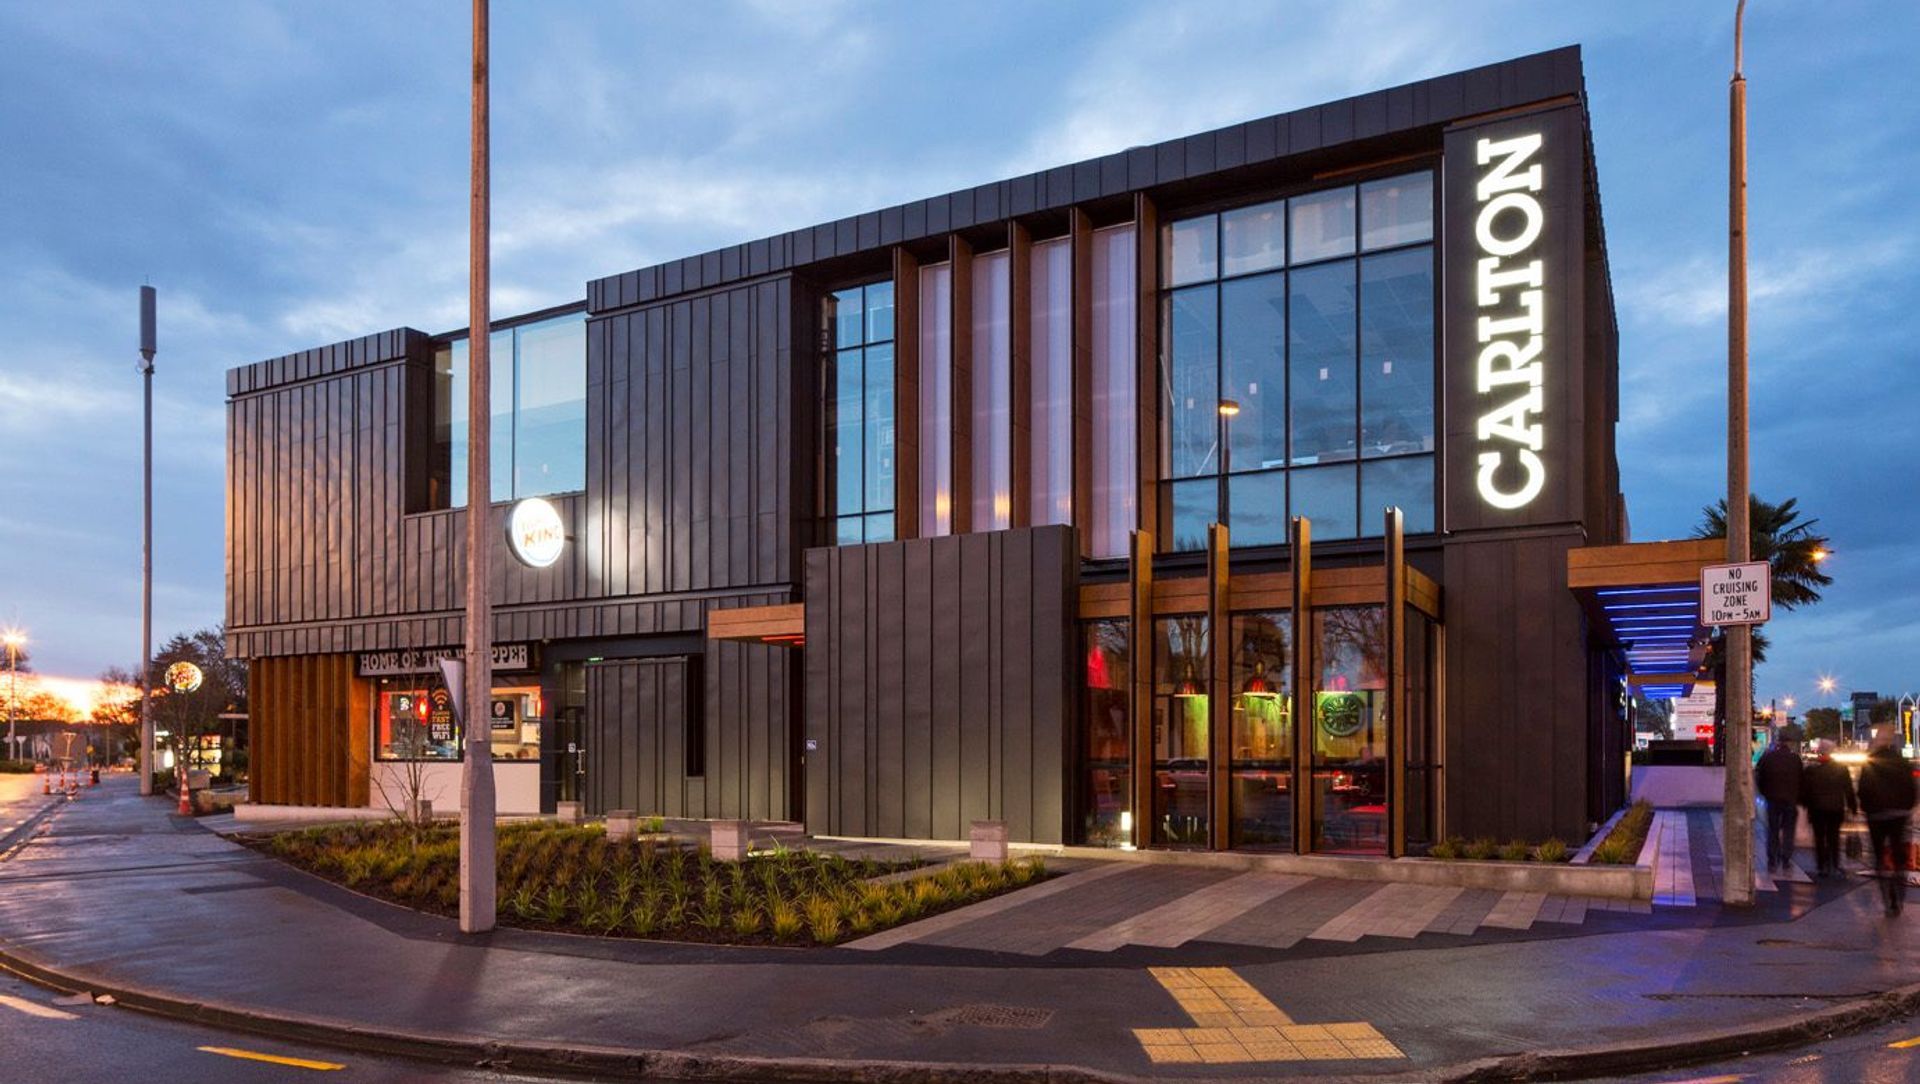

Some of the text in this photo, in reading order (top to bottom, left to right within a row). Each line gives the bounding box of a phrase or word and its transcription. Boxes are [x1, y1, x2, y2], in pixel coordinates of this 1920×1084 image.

[1475, 132, 1546, 511] CARLTON
[1728, 567, 1742, 580] NO
[1712, 580, 1758, 595] CRUISING
[1723, 594, 1748, 608] ZONE
[360, 652, 399, 670] HOME
[401, 651, 418, 670] OF
